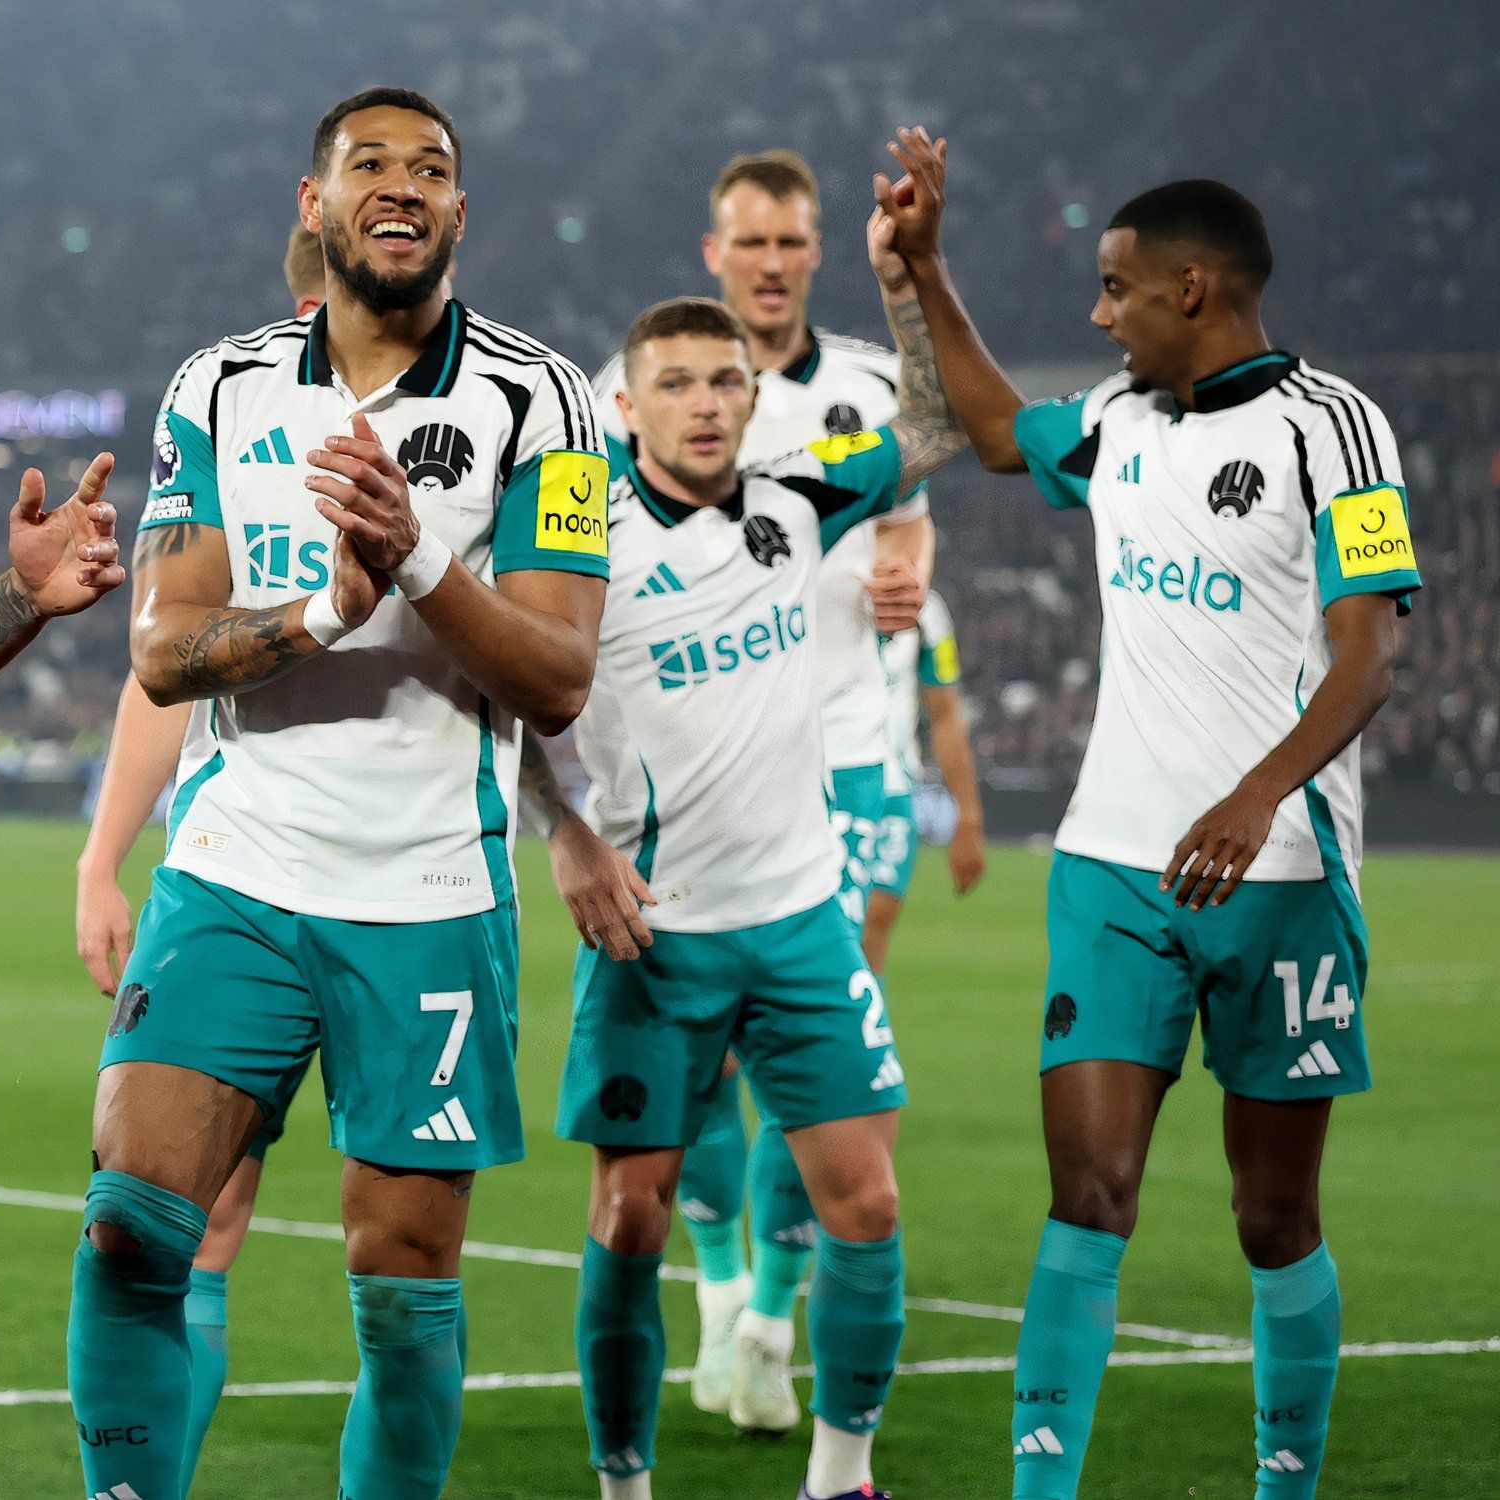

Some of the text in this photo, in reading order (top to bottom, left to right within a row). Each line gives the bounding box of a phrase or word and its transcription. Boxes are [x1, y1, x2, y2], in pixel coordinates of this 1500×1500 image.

[545, 512, 603, 538] noon
[1345, 539, 1407, 561] noon
[1137, 555, 1242, 612] sela
[715, 604, 806, 672] sela
[848, 969, 894, 1050] 2
[1273, 953, 1355, 1037] 14
[420, 990, 473, 1086] 7
